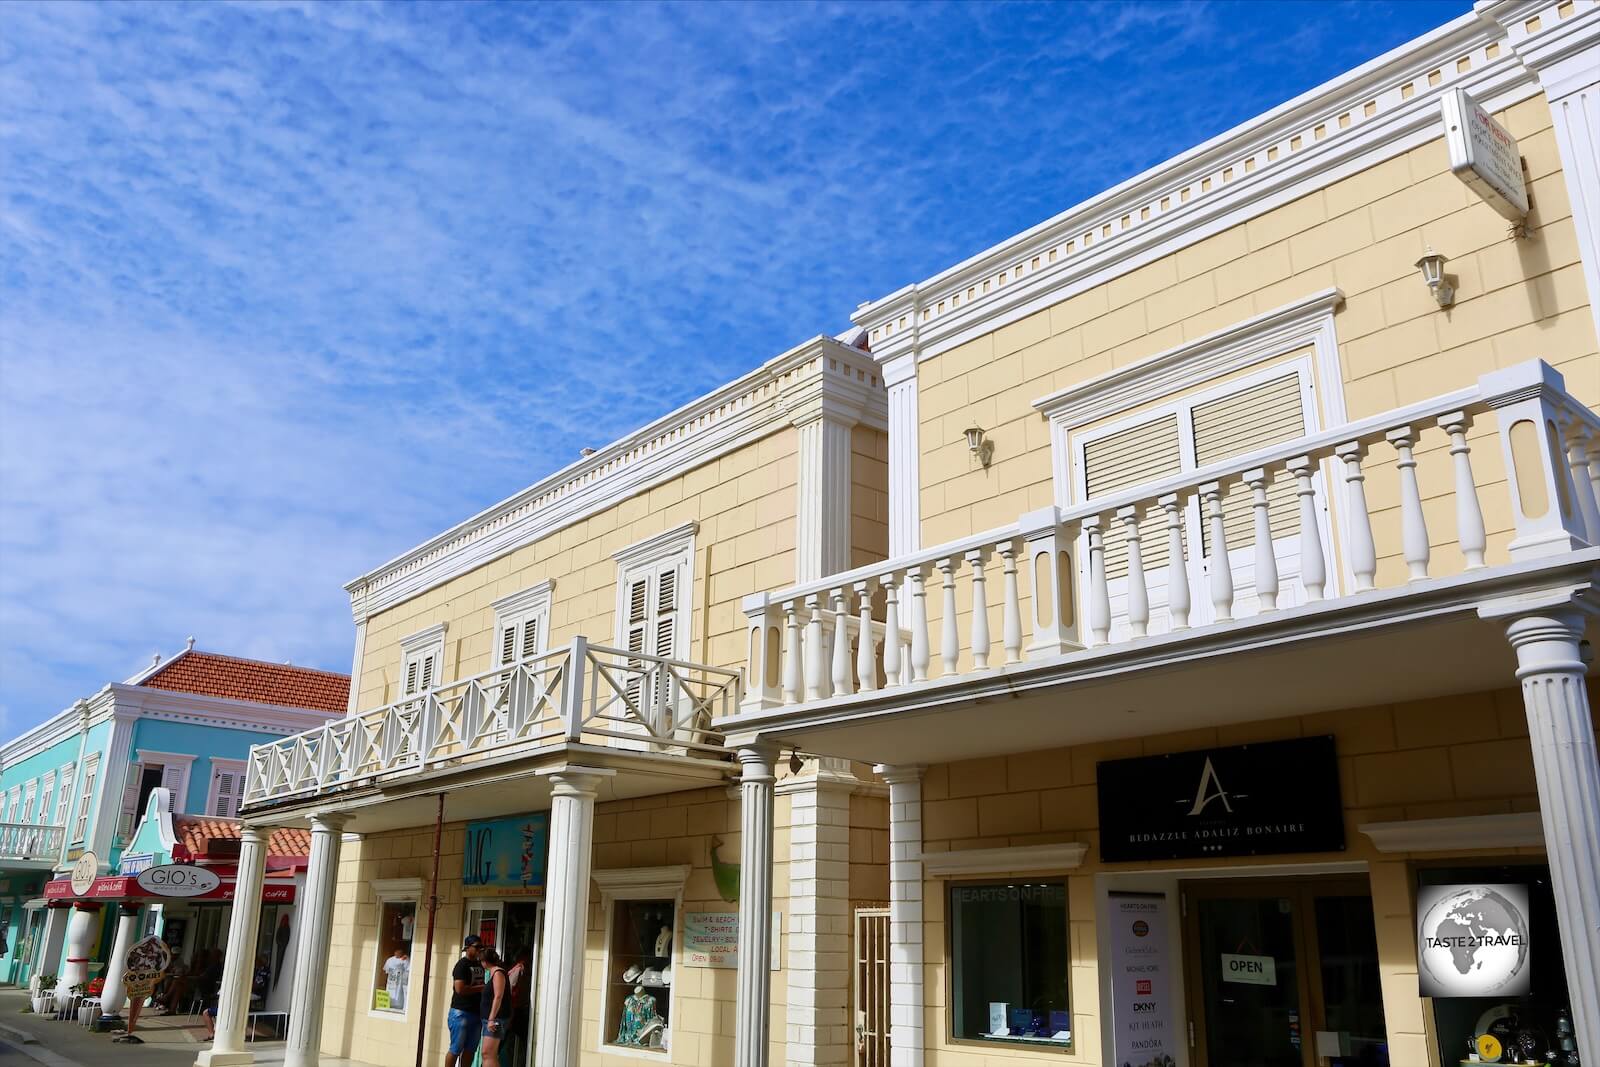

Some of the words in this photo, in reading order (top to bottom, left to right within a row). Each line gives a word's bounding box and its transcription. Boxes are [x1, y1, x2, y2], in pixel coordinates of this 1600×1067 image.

[1186, 755, 1233, 816] A
[1129, 831, 1188, 843] BEDAZZLE
[1194, 828, 1239, 839] ADALIZ
[1246, 823, 1305, 835] BONAIRE
[151, 869, 198, 885] GIO's
[711, 945, 731, 953] LOCAL
[1230, 960, 1263, 973] OPEN
[1133, 1002, 1156, 1012] DKNY
